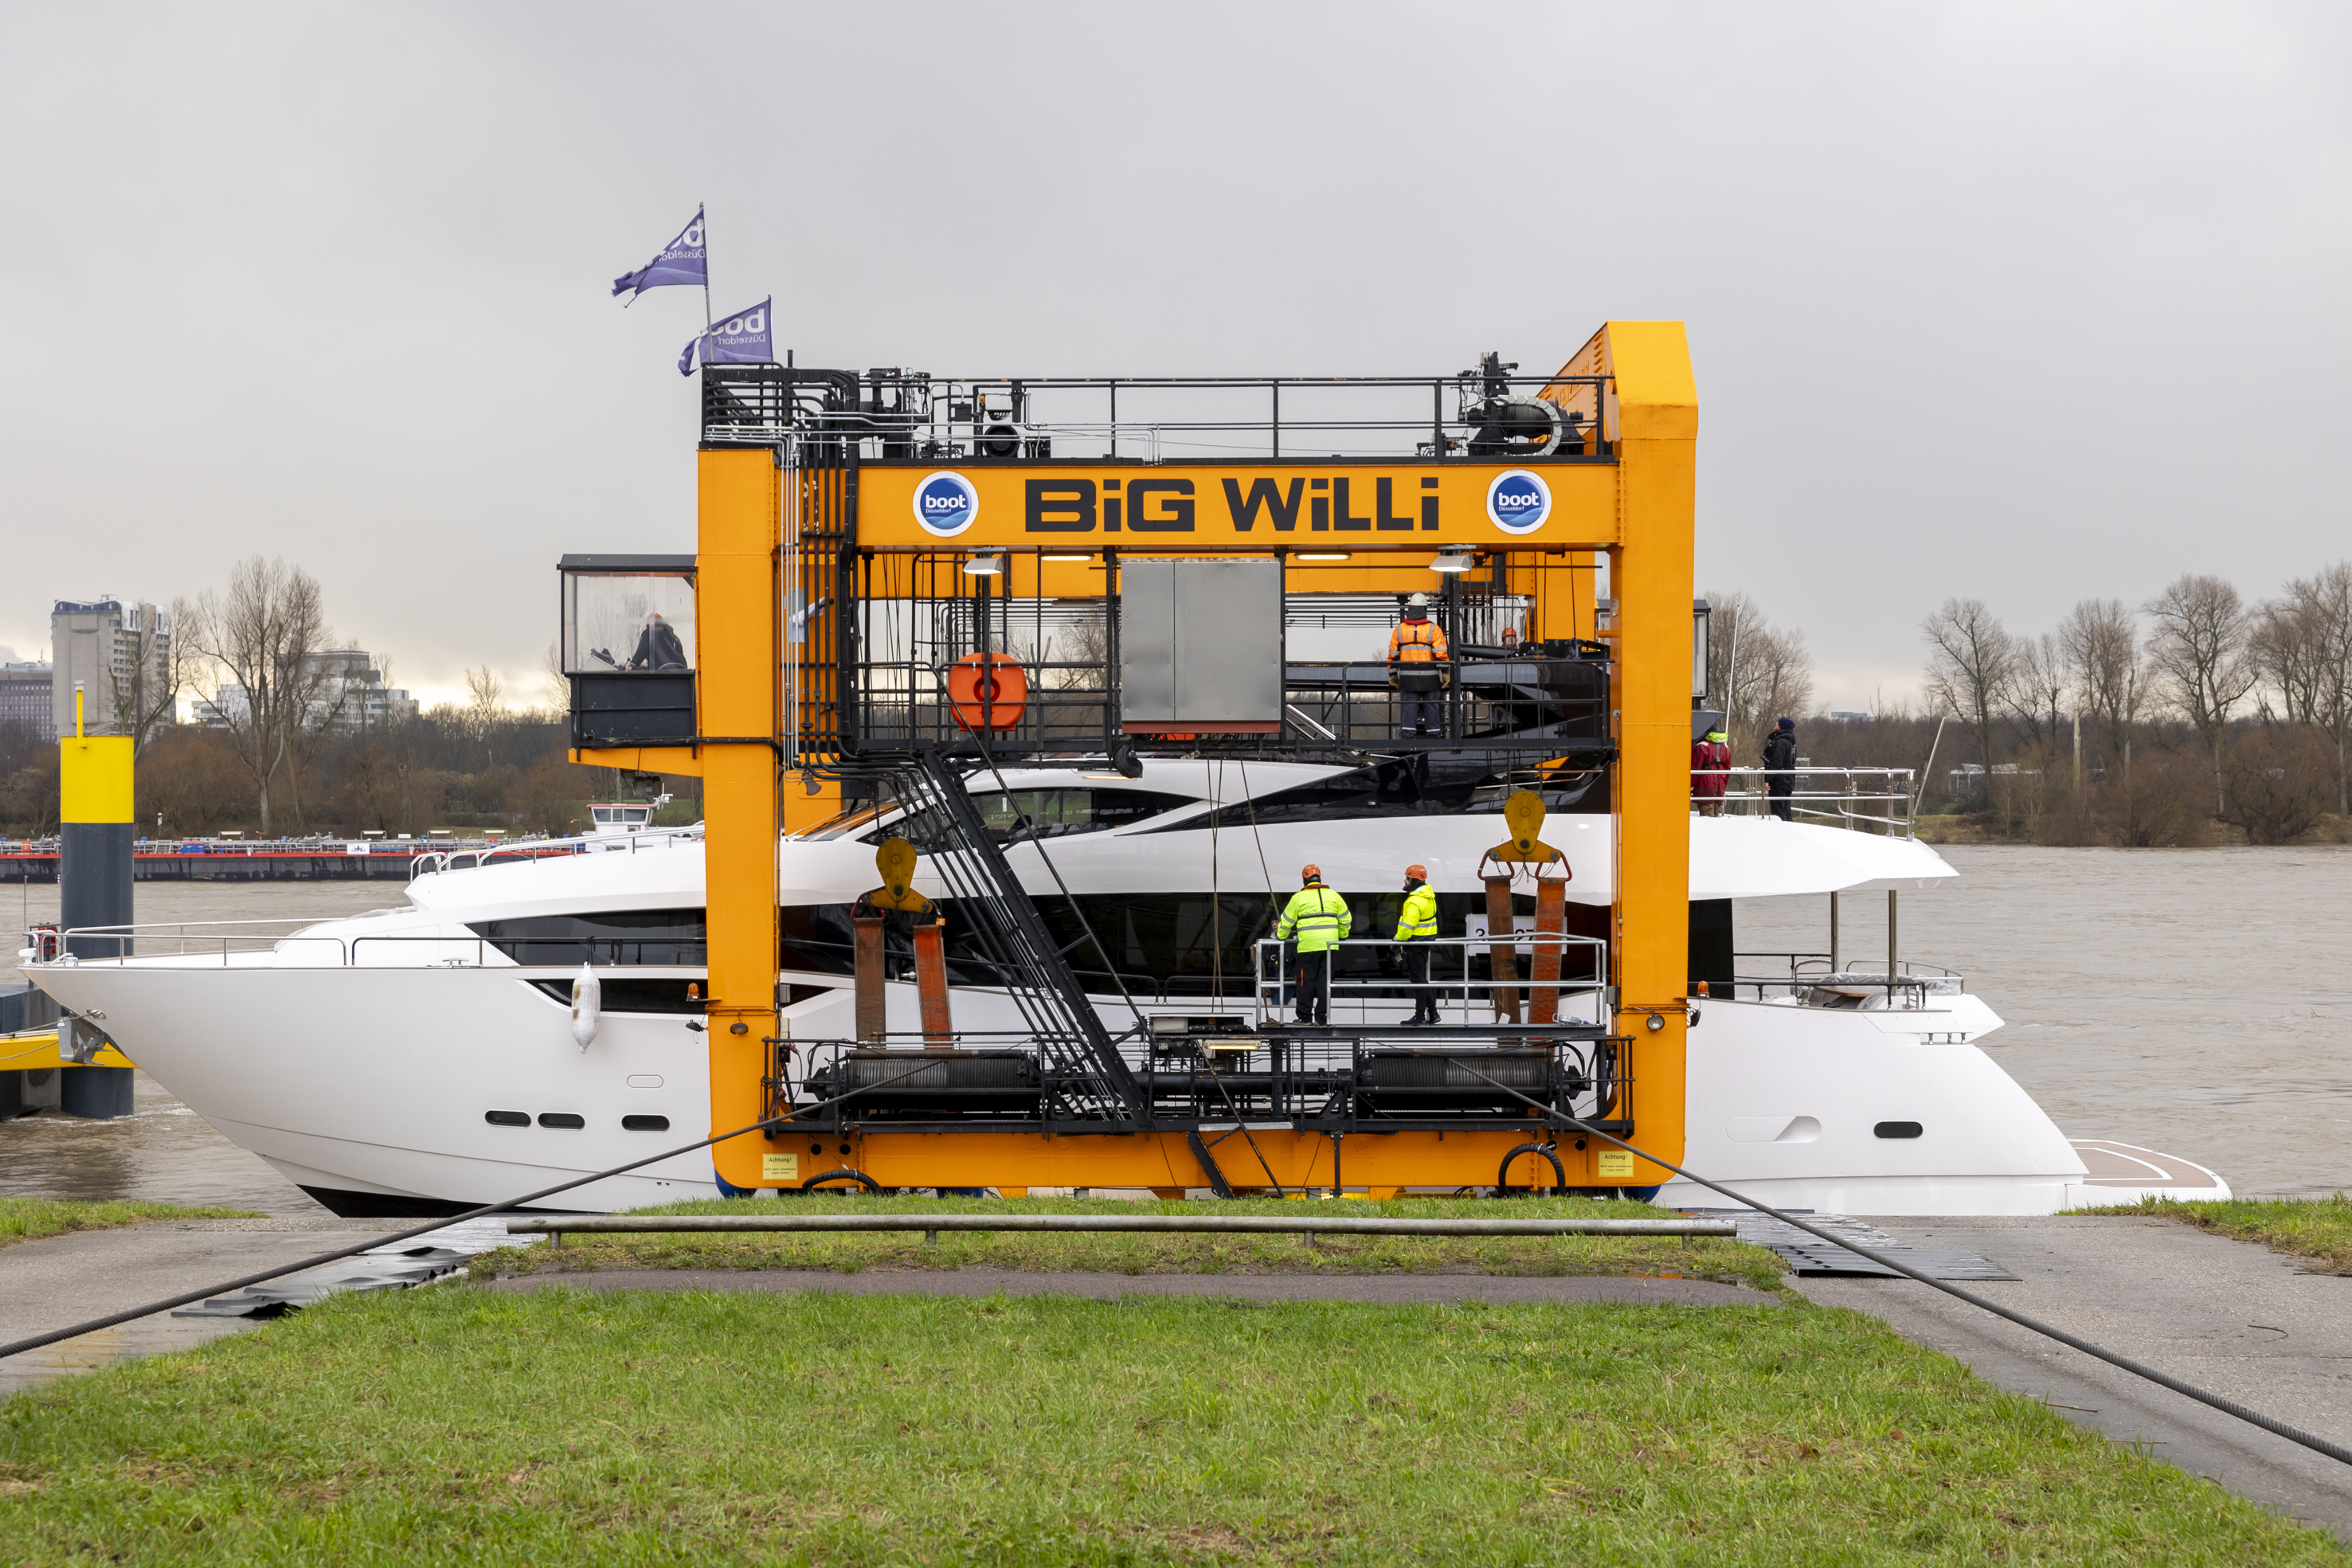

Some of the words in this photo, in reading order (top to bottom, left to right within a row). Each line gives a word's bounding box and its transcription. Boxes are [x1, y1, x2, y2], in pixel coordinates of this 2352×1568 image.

[926, 495, 966, 508] boot
[1025, 479, 1195, 532] BiG
[1221, 477, 1439, 531] WiLLi
[1498, 492, 1540, 506] boot
